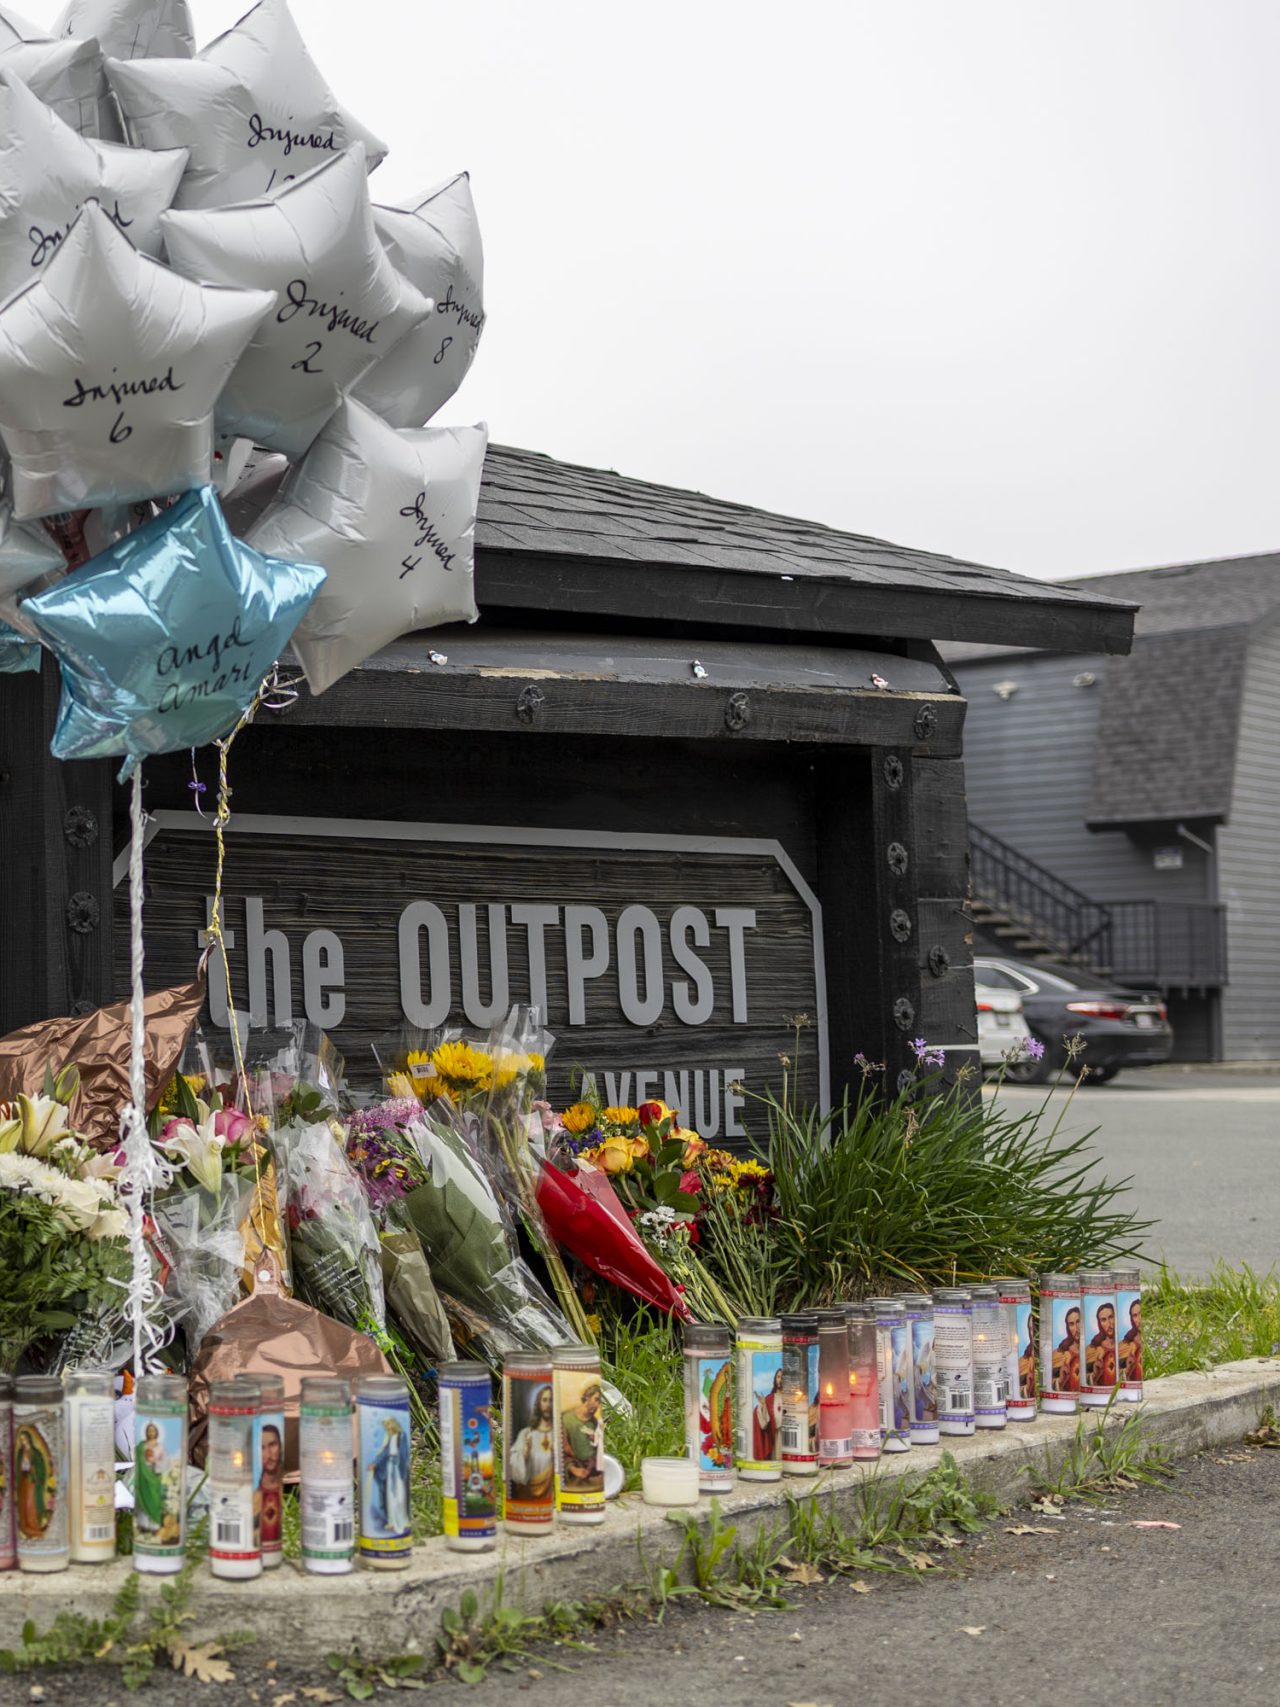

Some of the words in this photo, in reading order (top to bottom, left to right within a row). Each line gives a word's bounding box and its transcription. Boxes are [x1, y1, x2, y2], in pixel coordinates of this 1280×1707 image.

[247, 113, 344, 156] Injured
[276, 279, 377, 345] Injured
[436, 285, 484, 330] Injured
[290, 341, 322, 374] 2
[433, 336, 453, 365] 8
[63, 367, 185, 408] Injured
[108, 411, 133, 444] 6
[399, 491, 453, 572] Injured
[399, 554, 424, 580] 4
[198, 896, 346, 1030] the
[397, 899, 757, 1030] OUTPOST
